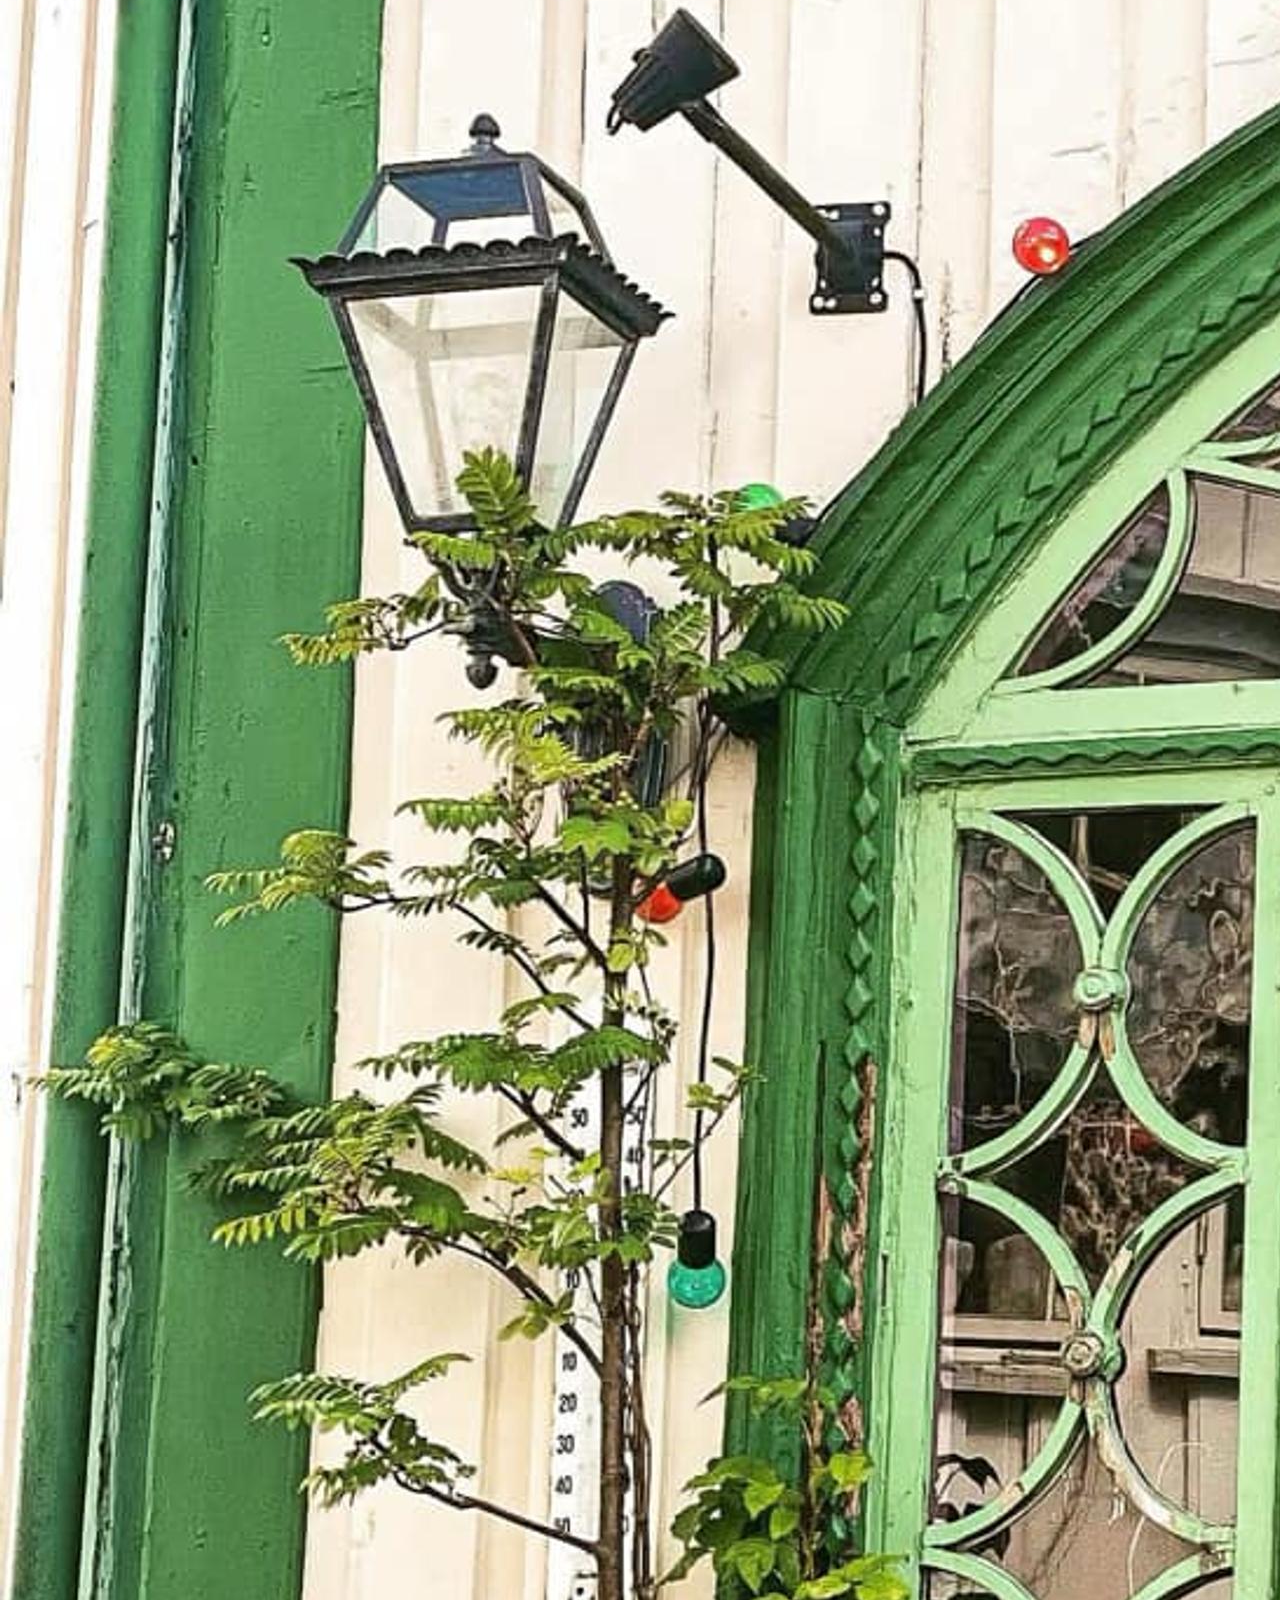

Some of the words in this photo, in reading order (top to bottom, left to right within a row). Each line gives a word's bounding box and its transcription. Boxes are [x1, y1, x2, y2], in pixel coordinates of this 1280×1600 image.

[562, 1352, 577, 1372] 10
[559, 1392, 578, 1414] 20
[556, 1434, 576, 1455] 30
[555, 1474, 573, 1495] 40
